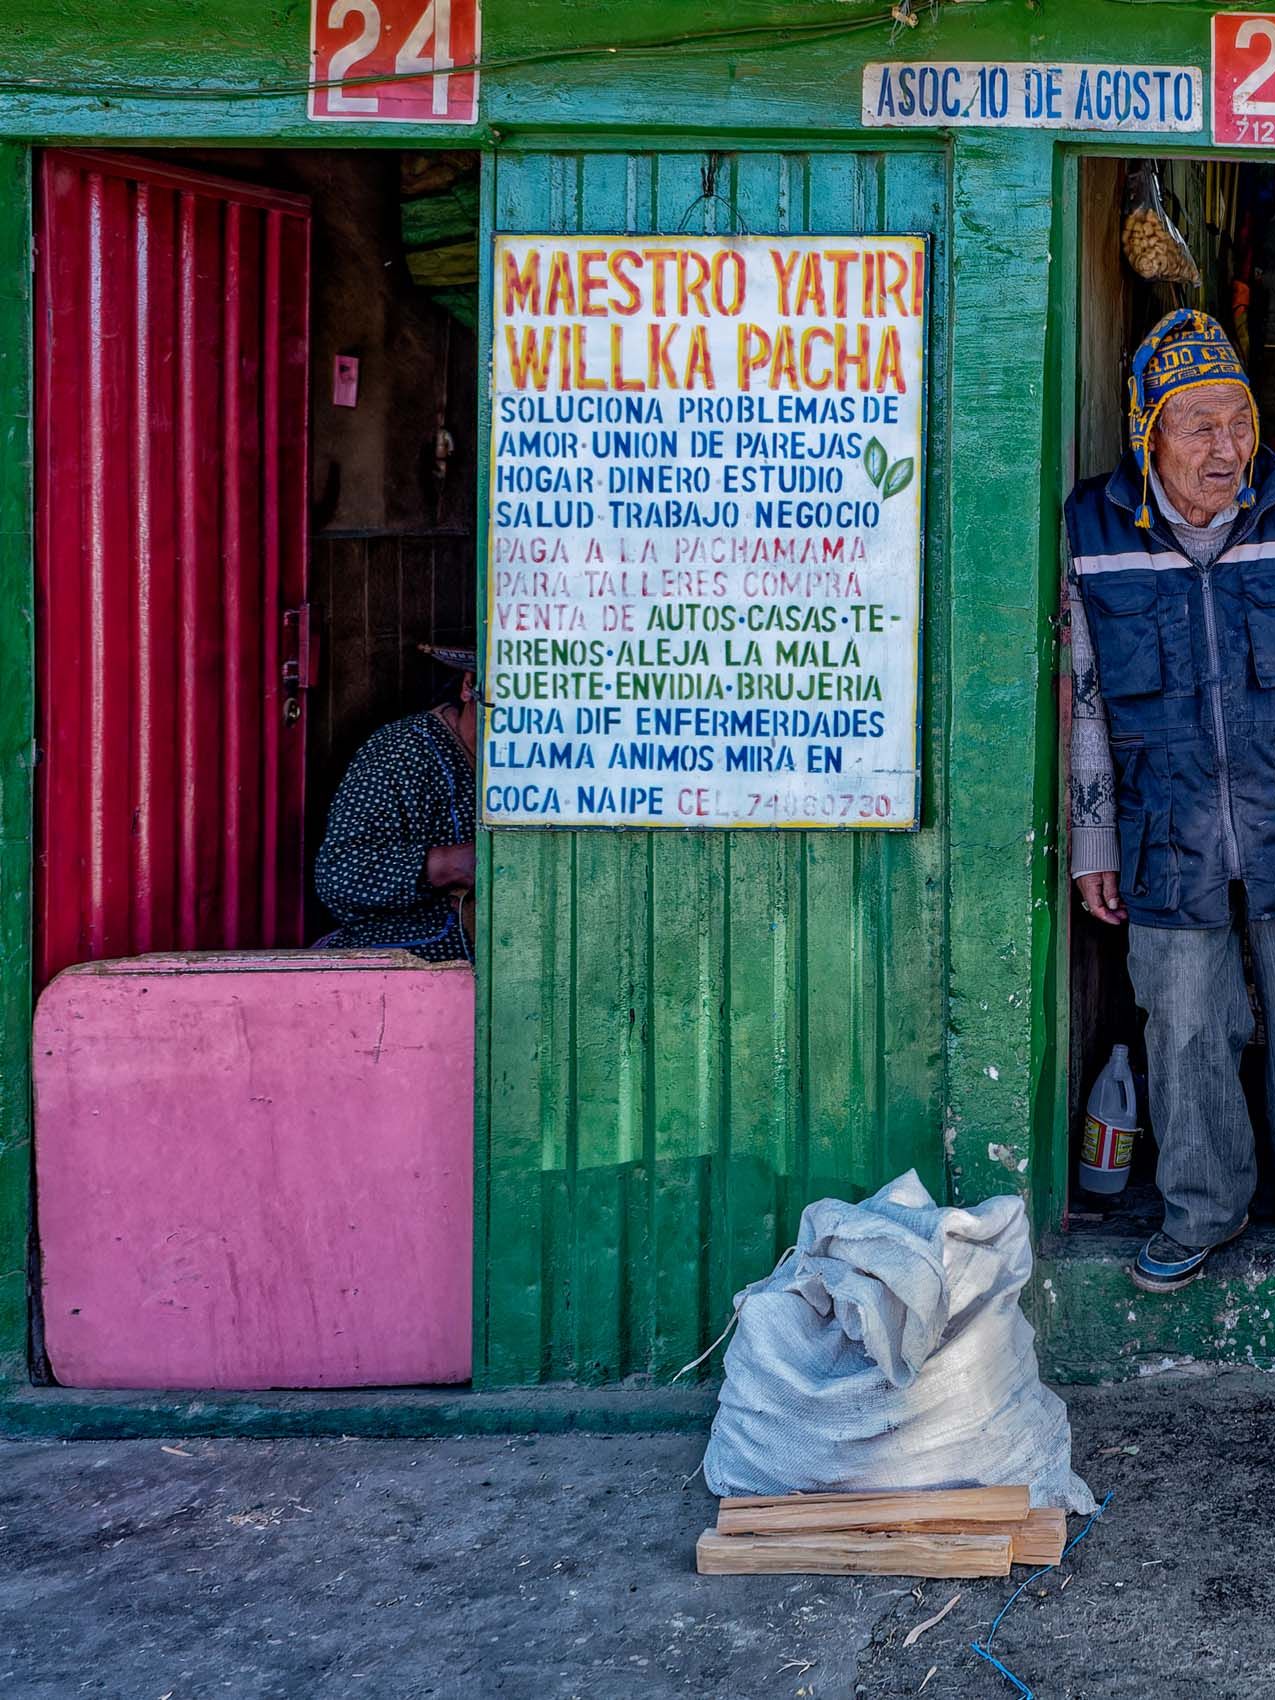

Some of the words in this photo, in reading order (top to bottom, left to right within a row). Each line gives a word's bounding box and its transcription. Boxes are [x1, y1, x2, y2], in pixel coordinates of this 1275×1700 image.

[327, 0, 454, 115] 24
[977, 66, 1009, 118] 10
[1023, 68, 1063, 120] DE
[1074, 69, 1193, 122] AGOSTO
[503, 249, 746, 317] MAESTRO
[770, 250, 925, 318] YATIRI
[504, 323, 716, 393] WILLKA
[737, 323, 907, 394] PACHA
[500, 396, 664, 424] SOLUCIONA
[679, 396, 855, 424] PROBLEMAS
[863, 396, 898, 424] DE
[690, 431, 724, 458] DE
[736, 432, 862, 459] PAREJAS
[497, 465, 593, 493] HOGAR
[608, 466, 710, 494] DINERO
[723, 465, 843, 494] ESTUDIO
[497, 500, 593, 529] SALUD
[609, 501, 740, 529] TRABAJO
[755, 501, 880, 529] NEGOCIO
[494, 537, 569, 564] PAGA
[584, 538, 604, 563] A
[620, 537, 658, 563] LA
[675, 537, 867, 563] PACHAMAMA
[494, 570, 570, 598] PARA
[584, 571, 727, 598] TALLERES
[743, 572, 862, 598] COMPRA
[498, 604, 585, 632] VENTA
[603, 604, 635, 632] DE
[725, 640, 762, 667] LA
[775, 640, 861, 667] MALA
[489, 707, 564, 735] CURA
[636, 708, 885, 738] ENFERMERDADES
[489, 741, 595, 769] LLAMA
[608, 743, 714, 772] ANIMOS
[726, 744, 795, 773] MIRA
[807, 746, 843, 773] EN
[486, 785, 561, 814] COCA
[578, 786, 664, 814] NAIPE
